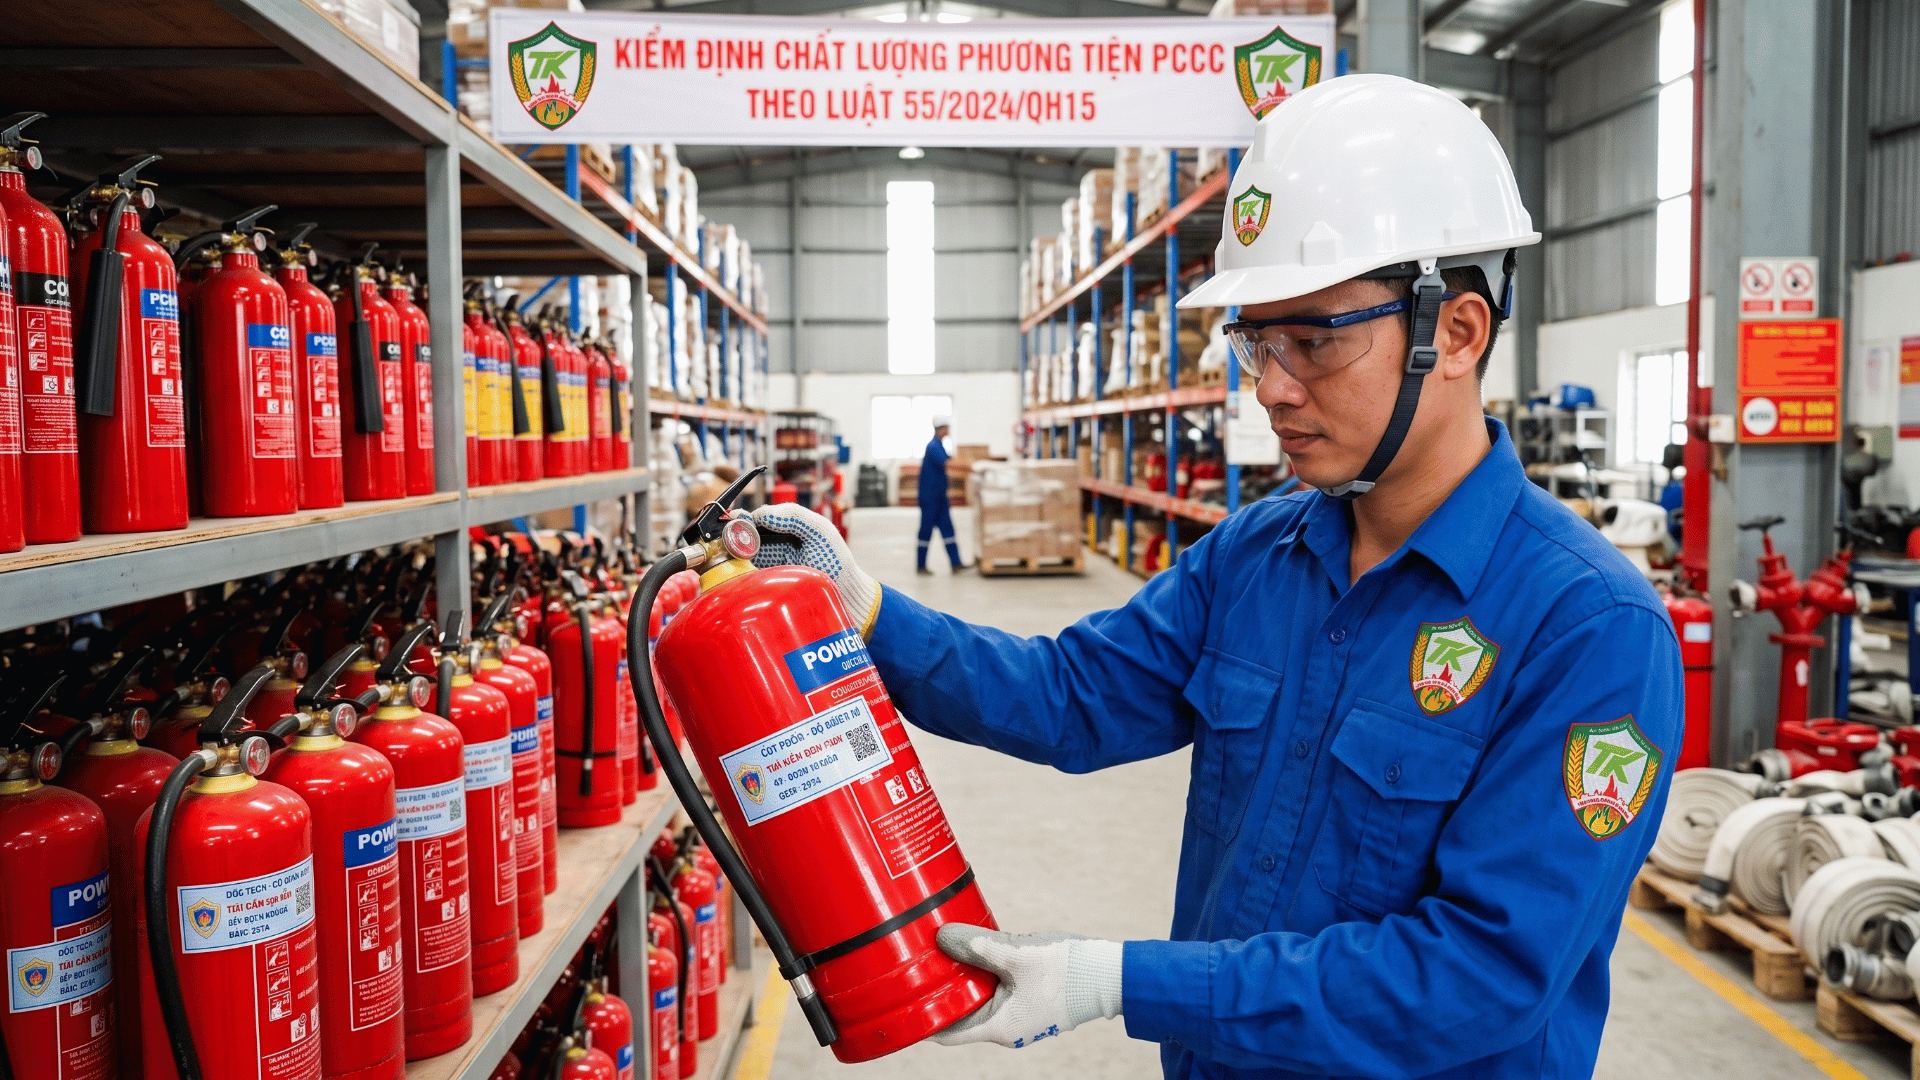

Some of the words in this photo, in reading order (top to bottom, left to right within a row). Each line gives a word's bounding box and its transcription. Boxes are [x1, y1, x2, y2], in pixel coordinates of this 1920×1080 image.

[528, 50, 578, 79] TK
[615, 28, 686, 70] KIỂM
[696, 39, 764, 77] ĐỊNH
[775, 29, 846, 71] CHẤT
[857, 40, 948, 84] LƯỢNG
[959, 41, 1072, 73] PHƯƠNG
[1082, 37, 1142, 80] TIỆN
[1152, 43, 1226, 74] PCCC
[1255, 54, 1303, 83] TK
[747, 89, 816, 120] THEO
[827, 83, 894, 127] LUẬT
[904, 91, 1096, 124] 55/2024/QH15
